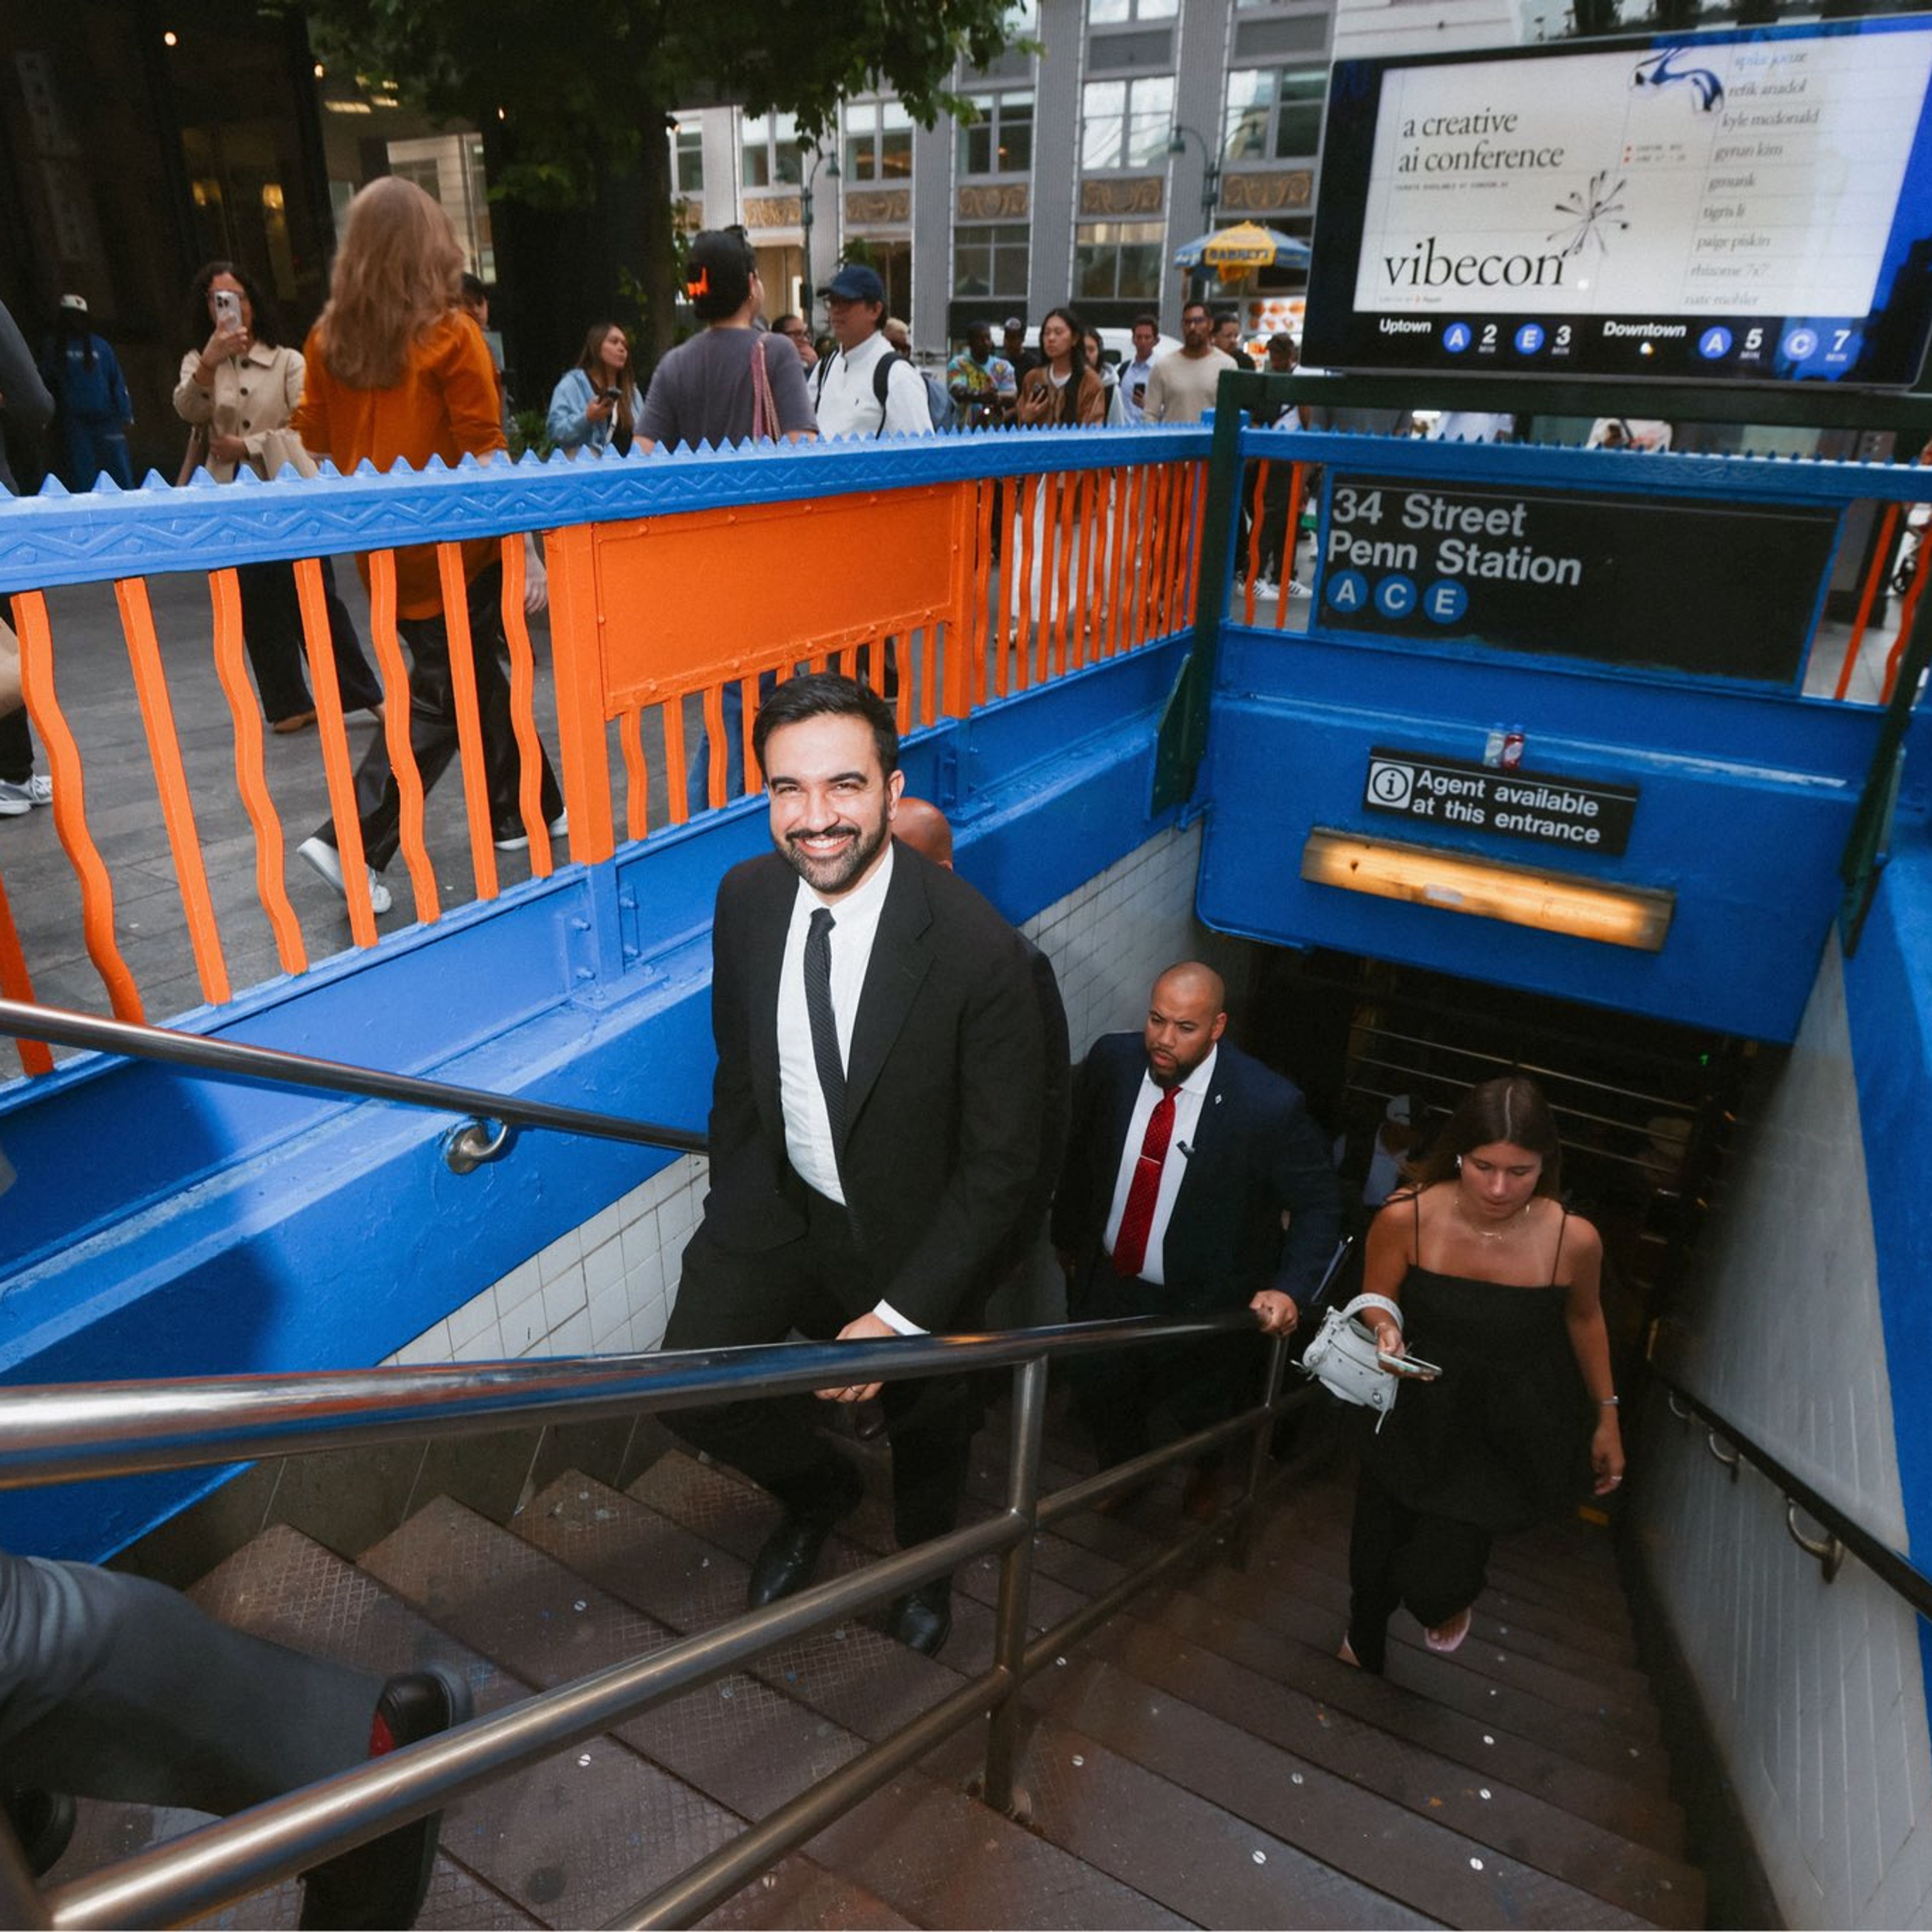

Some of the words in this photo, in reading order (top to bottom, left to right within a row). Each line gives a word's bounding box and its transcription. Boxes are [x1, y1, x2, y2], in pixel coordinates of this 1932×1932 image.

[1403, 119, 1415, 138] a
[1422, 107, 1518, 137] creative
[1398, 146, 1419, 173] ai
[1425, 139, 1565, 170] conference
[1385, 236, 1564, 286] vibecon
[1379, 318, 1432, 335] Uptown
[1448, 328, 1465, 347] A
[1482, 324, 1498, 344] 2
[1521, 330, 1538, 348] E
[1556, 325, 1572, 346] 3
[1603, 320, 1686, 338] Downtown
[1706, 332, 1723, 352] A
[1744, 328, 1763, 351] 5
[1790, 334, 1811, 355] C
[1833, 329, 1852, 352] 7
[1739, 351, 1760, 360] MIN
[1825, 353, 1848, 362] MIN
[1332, 488, 1383, 525] 34
[1401, 493, 1528, 537] Street
[1327, 530, 1418, 570] Penn
[1435, 538, 1582, 586] Station
[1335, 579, 1356, 604] A
[1384, 583, 1407, 610] C
[1434, 588, 1457, 615] E
[1416, 769, 1487, 796] Agent
[1494, 785, 1599, 817] available
[1412, 797, 1435, 816] at
[1444, 799, 1486, 824] this
[1494, 813, 1600, 844] entrance
